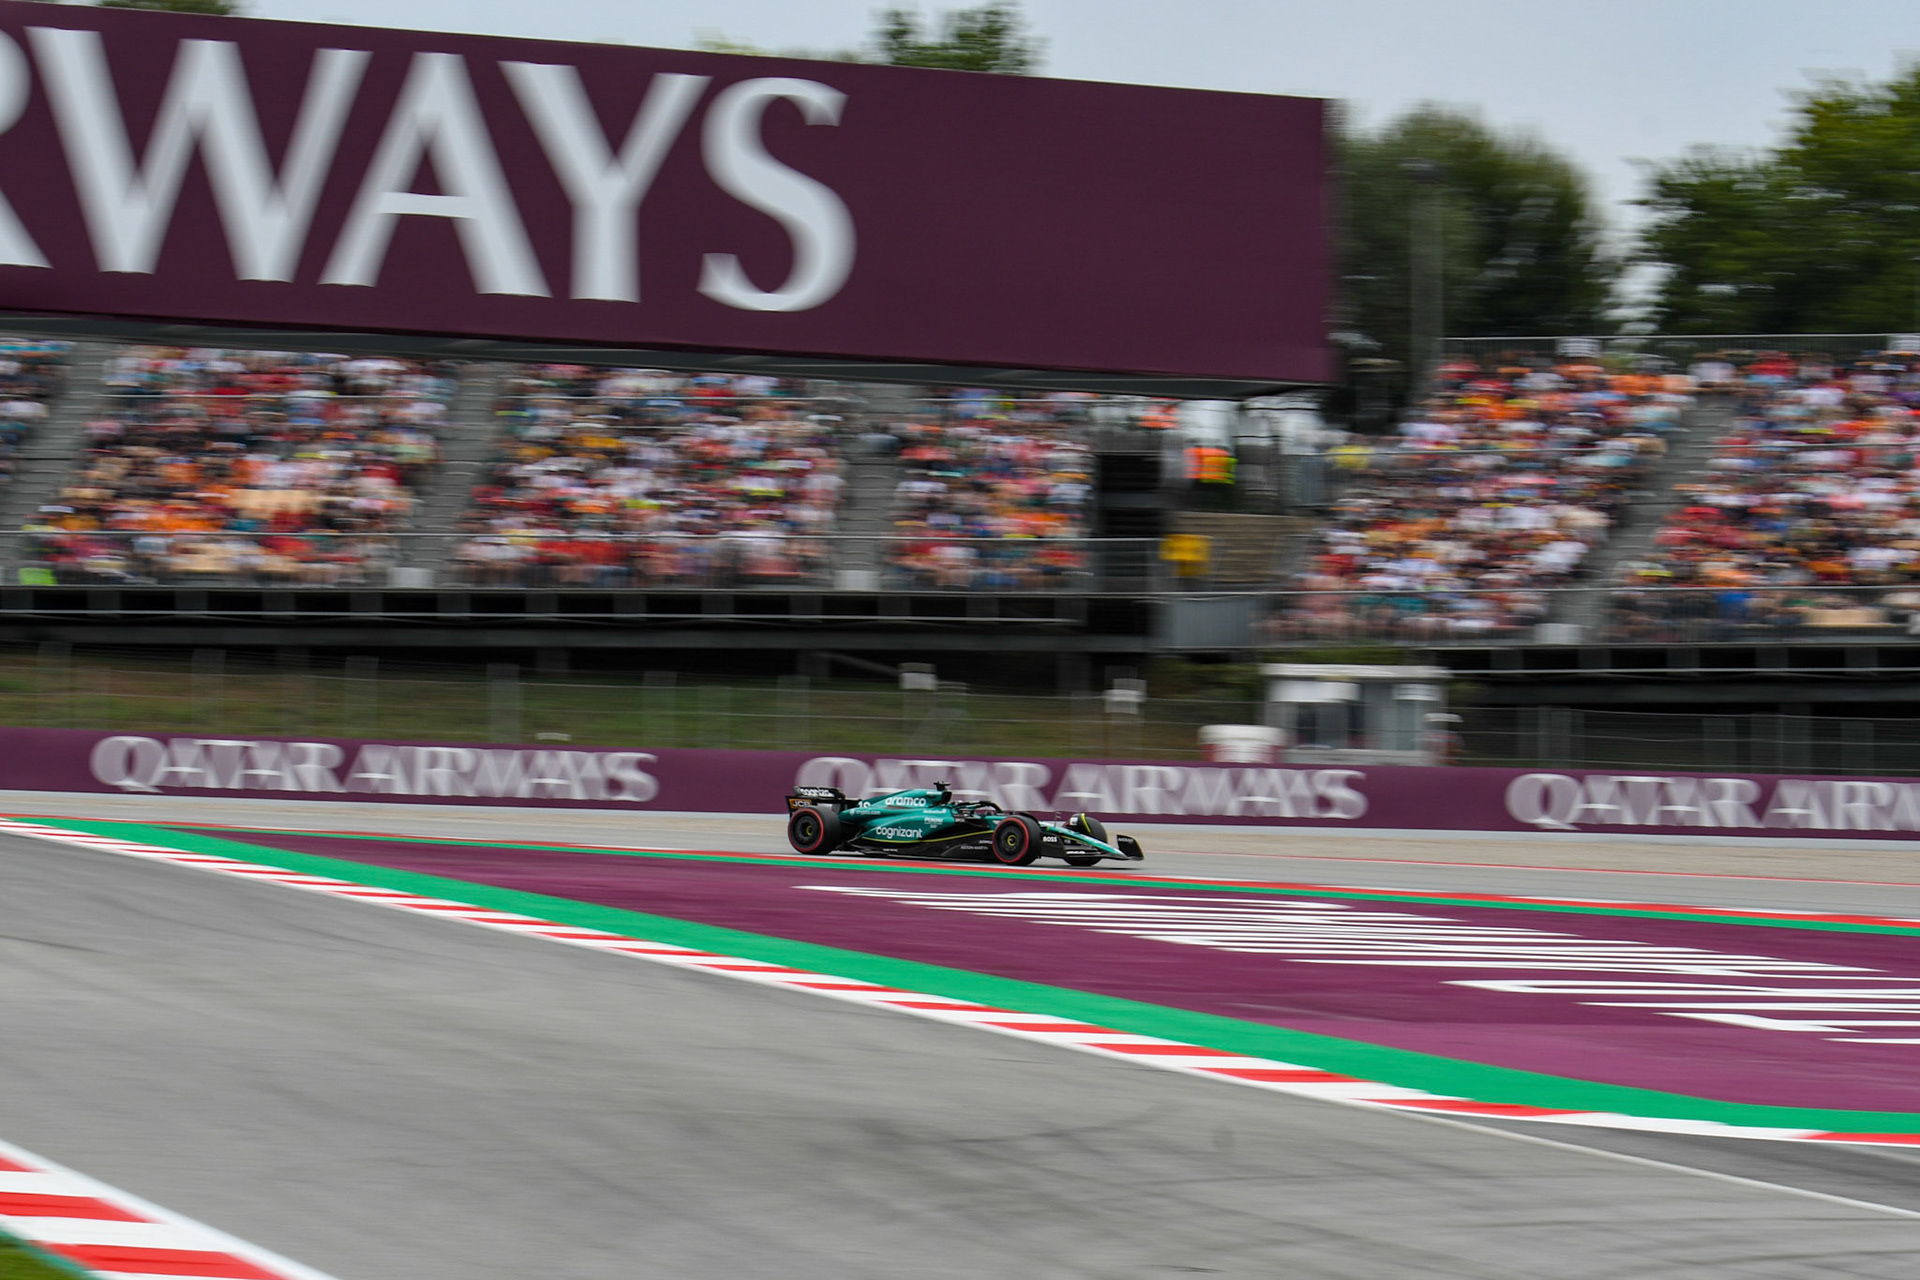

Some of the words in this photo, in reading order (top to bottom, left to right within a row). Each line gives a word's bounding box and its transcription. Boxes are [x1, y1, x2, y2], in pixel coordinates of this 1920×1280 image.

[0, 26, 857, 312] WAYS
[90, 735, 347, 793] QATAR
[345, 743, 659, 802] AIRWAYS
[1053, 764, 1368, 820] AIRWAYS
[885, 796, 926, 807] aramco
[1505, 773, 1763, 831] QATAR
[876, 826, 923, 839] cognizant
